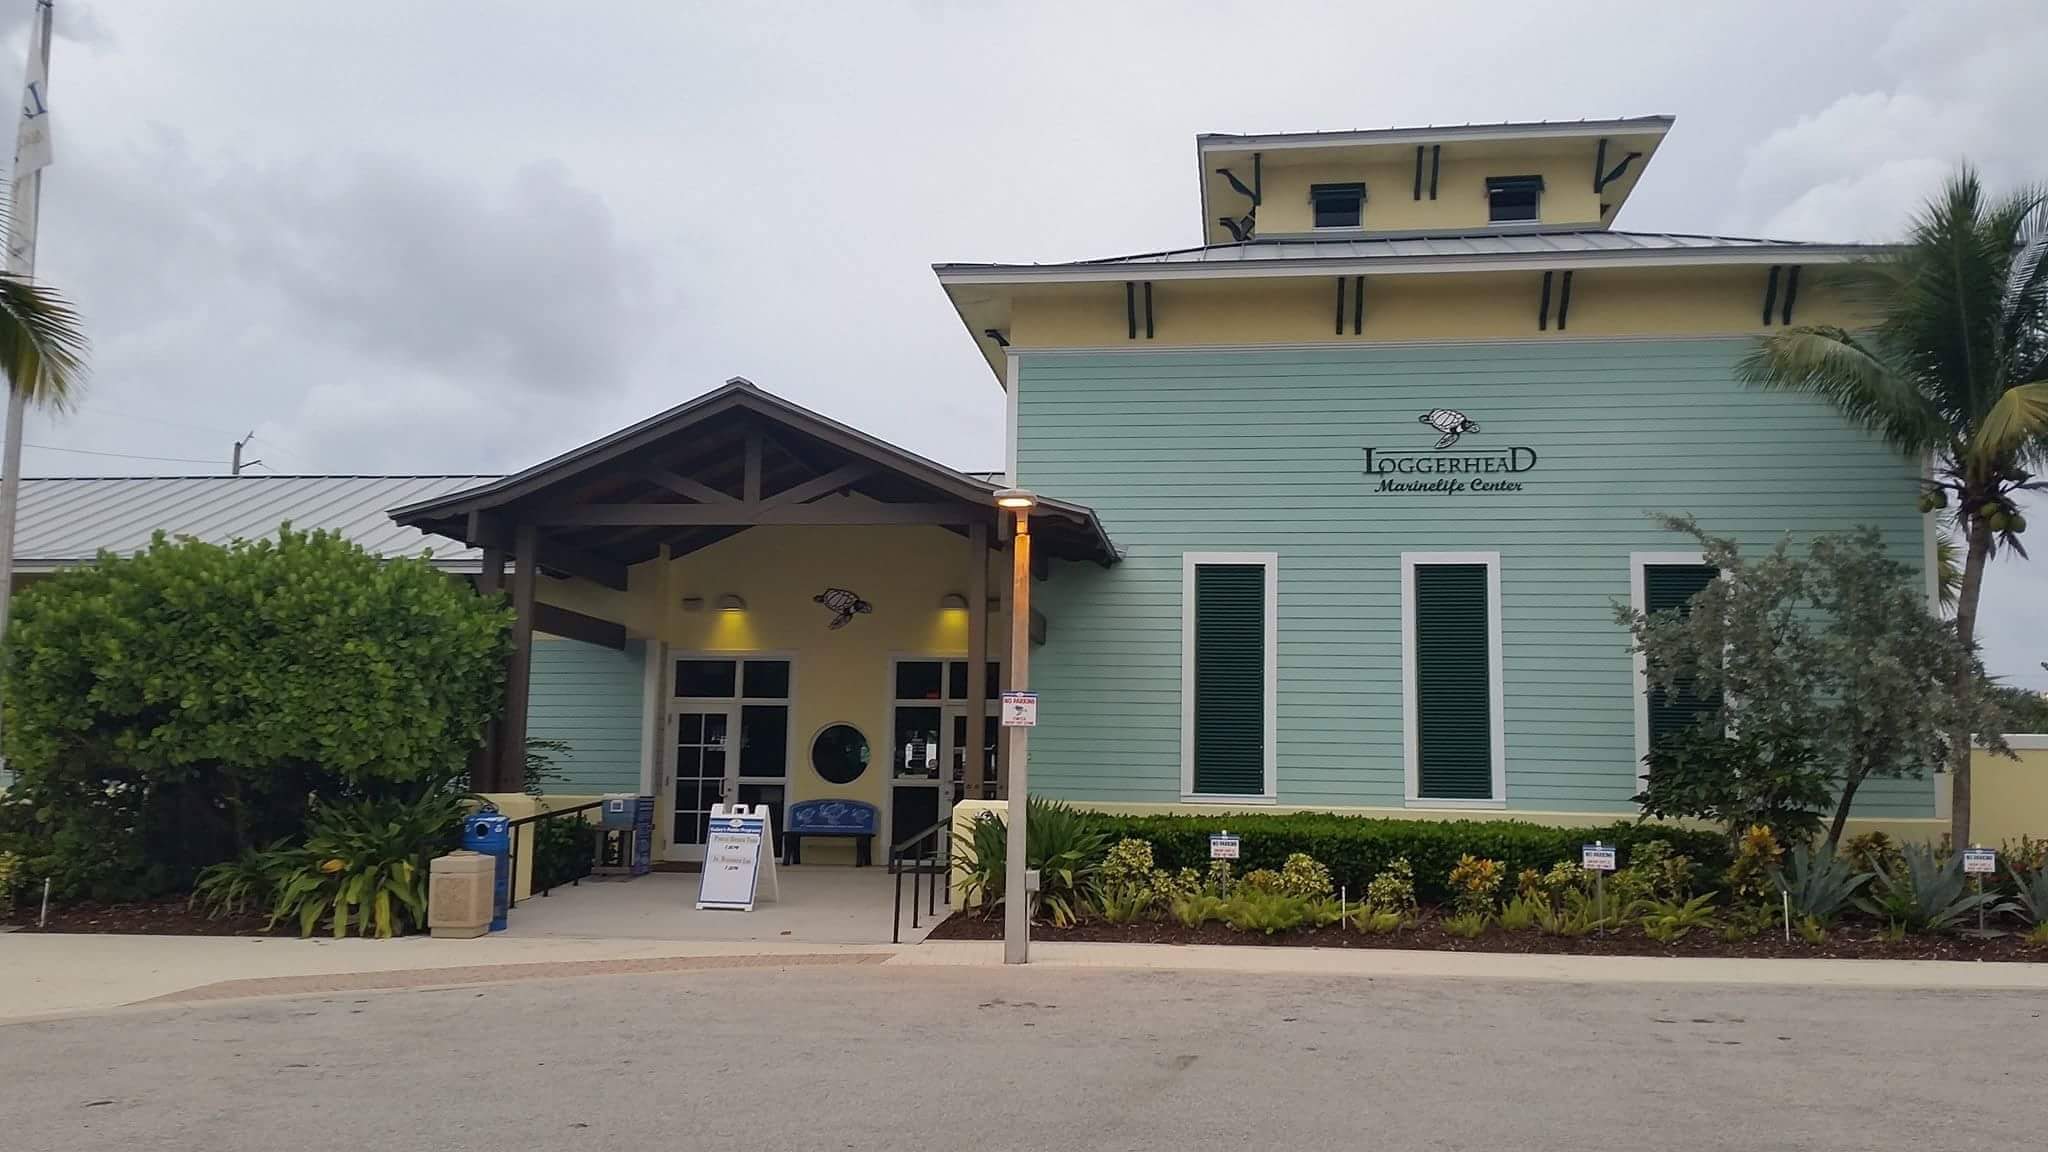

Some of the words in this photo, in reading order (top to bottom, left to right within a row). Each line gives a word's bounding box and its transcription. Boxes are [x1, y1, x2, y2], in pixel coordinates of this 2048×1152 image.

[1362, 446, 1537, 476] LOGGERHEAD
[1374, 478, 1465, 495] Marinelife
[1470, 477, 1523, 491] Center
